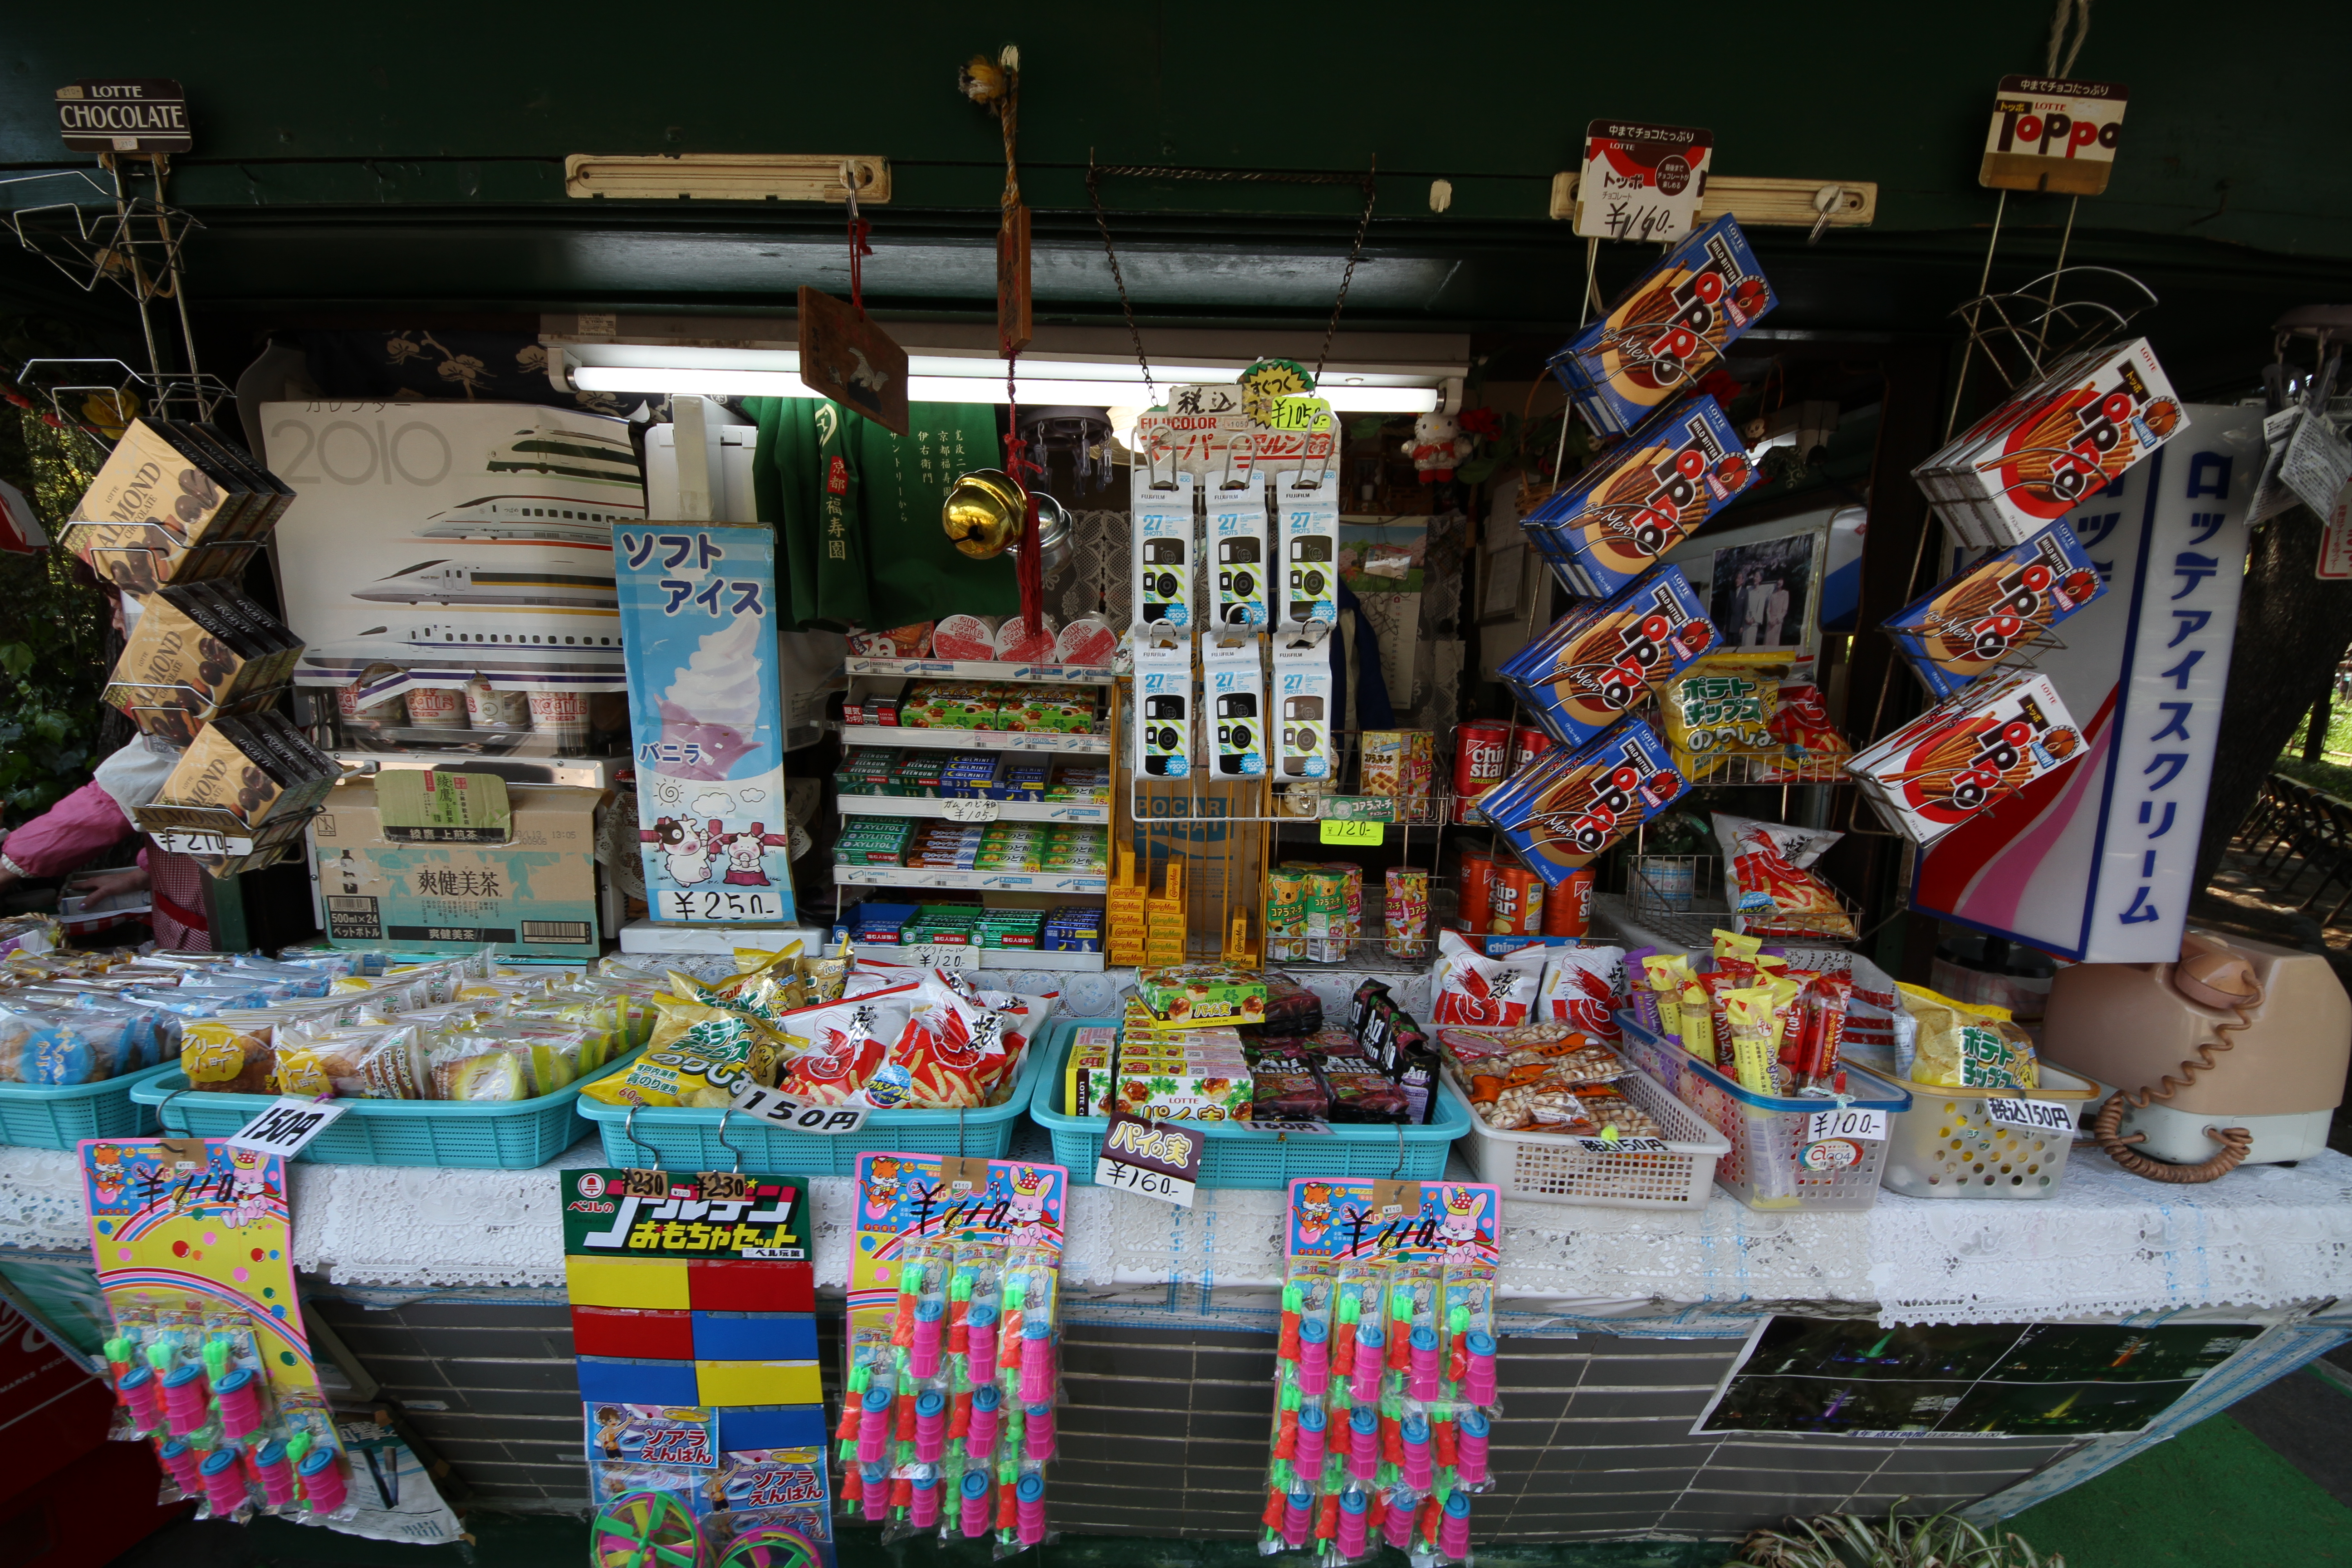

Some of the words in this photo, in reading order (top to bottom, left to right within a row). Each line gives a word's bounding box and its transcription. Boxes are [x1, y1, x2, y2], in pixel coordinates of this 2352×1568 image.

[92, 86, 142, 97] LOTTE
[2020, 79, 2109, 97] 中までチョコたっぷり
[60, 105, 185, 128] CHOCOLATE
[2000, 103, 2025, 113] トッポ
[2034, 102, 2067, 112] LOTTE
[1609, 125, 1694, 143] 中までチョコたっぷり
[1610, 142, 1635, 151] LOTTE
[1657, 173, 1690, 181] チョコレートが
[1665, 164, 1684, 172] 最後まで
[1603, 171, 1644, 190] トッポ
[1602, 191, 1632, 201] チョコレート
[1727, 222, 1745, 250] LOTTE
[1711, 241, 1724, 259] MILD
[1720, 257, 1737, 282] BITTER
[2140, 347, 2157, 373] LOTTE
[2126, 370, 2143, 394] トッポ
[1141, 416, 1216, 429] FUJICOLOR
[1709, 404, 1727, 428] LOTTE
[1691, 421, 1705, 441] MILD
[1701, 438, 1717, 459] BITTER
[271, 419, 452, 487] 2010
[918, 431, 933, 484] 伊右衛門
[938, 431, 951, 496] 京都福寿園
[829, 461, 845, 491] 京都
[94, 461, 162, 552] ALMOND
[124, 494, 158, 540] CHOCOLATE
[1143, 514, 1163, 530] 27
[1218, 514, 1238, 530] 27
[1290, 512, 1311, 528] 27
[825, 496, 846, 560] 福寿園
[2058, 523, 2077, 547] LOTTE
[622, 533, 723, 572] ソフト
[2041, 538, 2055, 557] MILD
[2050, 555, 2065, 574] BITTER
[658, 579, 765, 617] アイス
[1657, 589, 1671, 609] MILD
[1667, 605, 1682, 623] BITTER
[135, 630, 182, 707] ALMOND
[159, 662, 183, 700] CHOCOLATE
[1145, 673, 1164, 688] 27
[1215, 672, 1234, 687] 27
[1284, 674, 1303, 689] 27
[1681, 676, 1755, 701] ポテト
[2119, 451, 2234, 925] ロッテアイスクリーム
[925, 685, 985, 698] パイの実
[1020, 687, 1078, 701] パイの実
[843, 706, 861, 716] 眠気
[1682, 697, 1763, 729] チップス
[2025, 702, 2043, 724] トッポ
[639, 741, 705, 765] バニラ
[1364, 753, 1394, 764] コアラのマーチ
[1627, 742, 1640, 761] MILD
[1636, 757, 1651, 775] BITTER
[1135, 799, 1221, 816] POCAR
[1351, 798, 1393, 812] コアラのマーチ
[409, 828, 435, 840] 綾鷹
[442, 829, 478, 841] 上煎茶
[1006, 832, 1035, 841] のど飴
[1071, 833, 1100, 843] のど飴
[1004, 843, 1033, 853] のど飴
[416, 869, 500, 897] 爽健美茶
[1112, 888, 1142, 897] CalorieMate
[1111, 901, 1141, 911] CalorieMate
[1315, 897, 1341, 906] コアラのマーチ
[1110, 914, 1140, 923] CalorieMate
[1271, 906, 1303, 917] コアラのマーチ
[333, 926, 380, 938] ペットボトル
[428, 928, 475, 940] 爽健美茶
[866, 933, 897, 941] 噛む人は強い
[934, 935, 965, 943] 噛む人は強い
[1115, 927, 1145, 936] CalorieMate
[1194, 1001, 1232, 1018] パイの実
[688, 1017, 755, 1047] ポテト
[1784, 1007, 1801, 1038] いちご
[181, 1032, 240, 1054] クリーム
[668, 1038, 755, 1064] チップス
[1960, 1025, 2015, 1068] ポテト
[1251, 1065, 1310, 1074] Raisin
[1321, 1065, 1381, 1075] Raisin
[626, 1073, 681, 1096] 青のり使用
[866, 1078, 911, 1101] カルシウム
[617, 1087, 645, 1106] 60g
[741, 1090, 860, 1130] 150円
[1988, 1098, 2073, 1130] 税込150円
[242, 1107, 325, 1146] 150円
[1249, 1121, 1321, 1132] 160円
[1109, 1121, 1193, 1170] パイの実
[567, 1200, 615, 1214] ベルの
[628, 1221, 798, 1251] おもちゃセット
[644, 1428, 706, 1446] ソアラ
[642, 1444, 713, 1465] えんばん
[754, 1470, 815, 1490] ソアラ
[748, 1488, 823, 1507] えんばん
